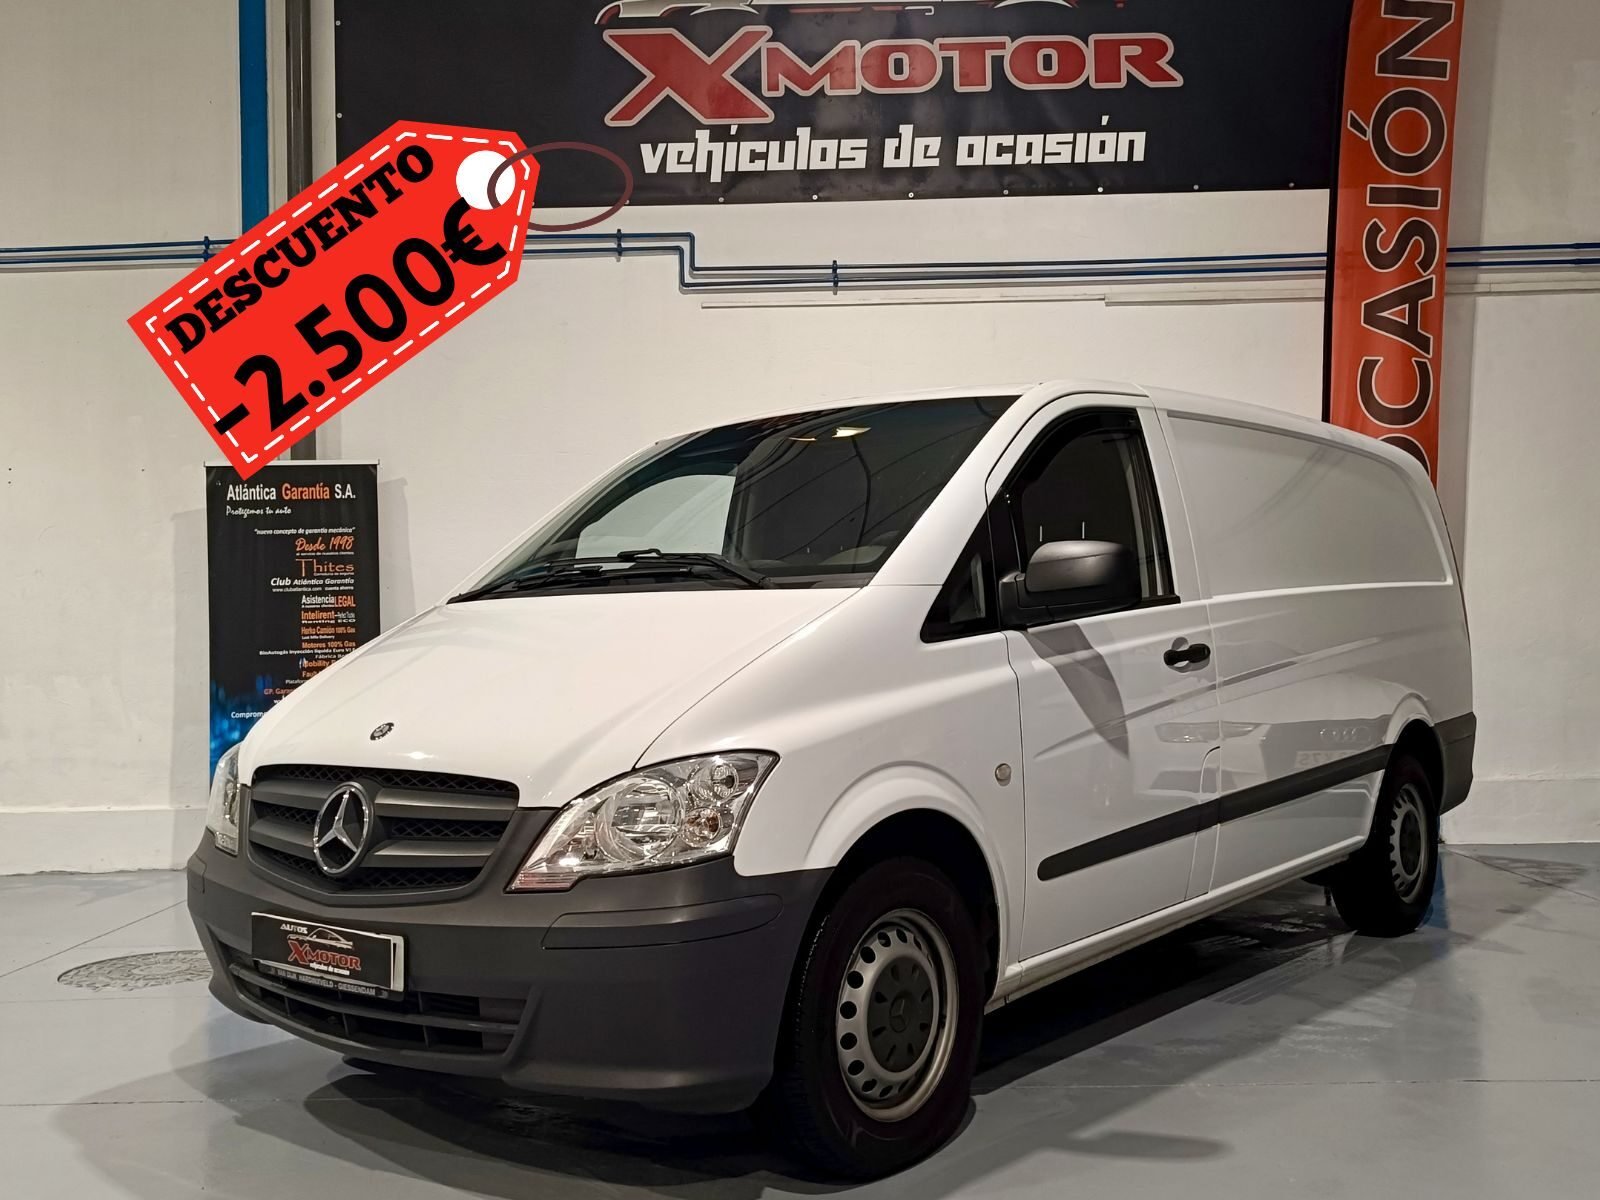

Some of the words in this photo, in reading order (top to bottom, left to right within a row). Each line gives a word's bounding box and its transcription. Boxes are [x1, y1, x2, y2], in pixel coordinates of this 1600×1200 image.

[603, 25, 1184, 127] XMOTOR
[640, 125, 868, 184] vehículos
[883, 124, 941, 169] de
[957, 115, 1146, 167] ocasión
[227, 483, 276, 500] Atlántica
[282, 482, 330, 500] Garantía
[334, 483, 356, 499] S.A.
[295, 537, 327, 551] Desde
[329, 535, 355, 551] 1998
[270, 577, 291, 586] Club
[280, 923, 308, 934] AUTOS
[287, 940, 361, 971] XMOTOR
